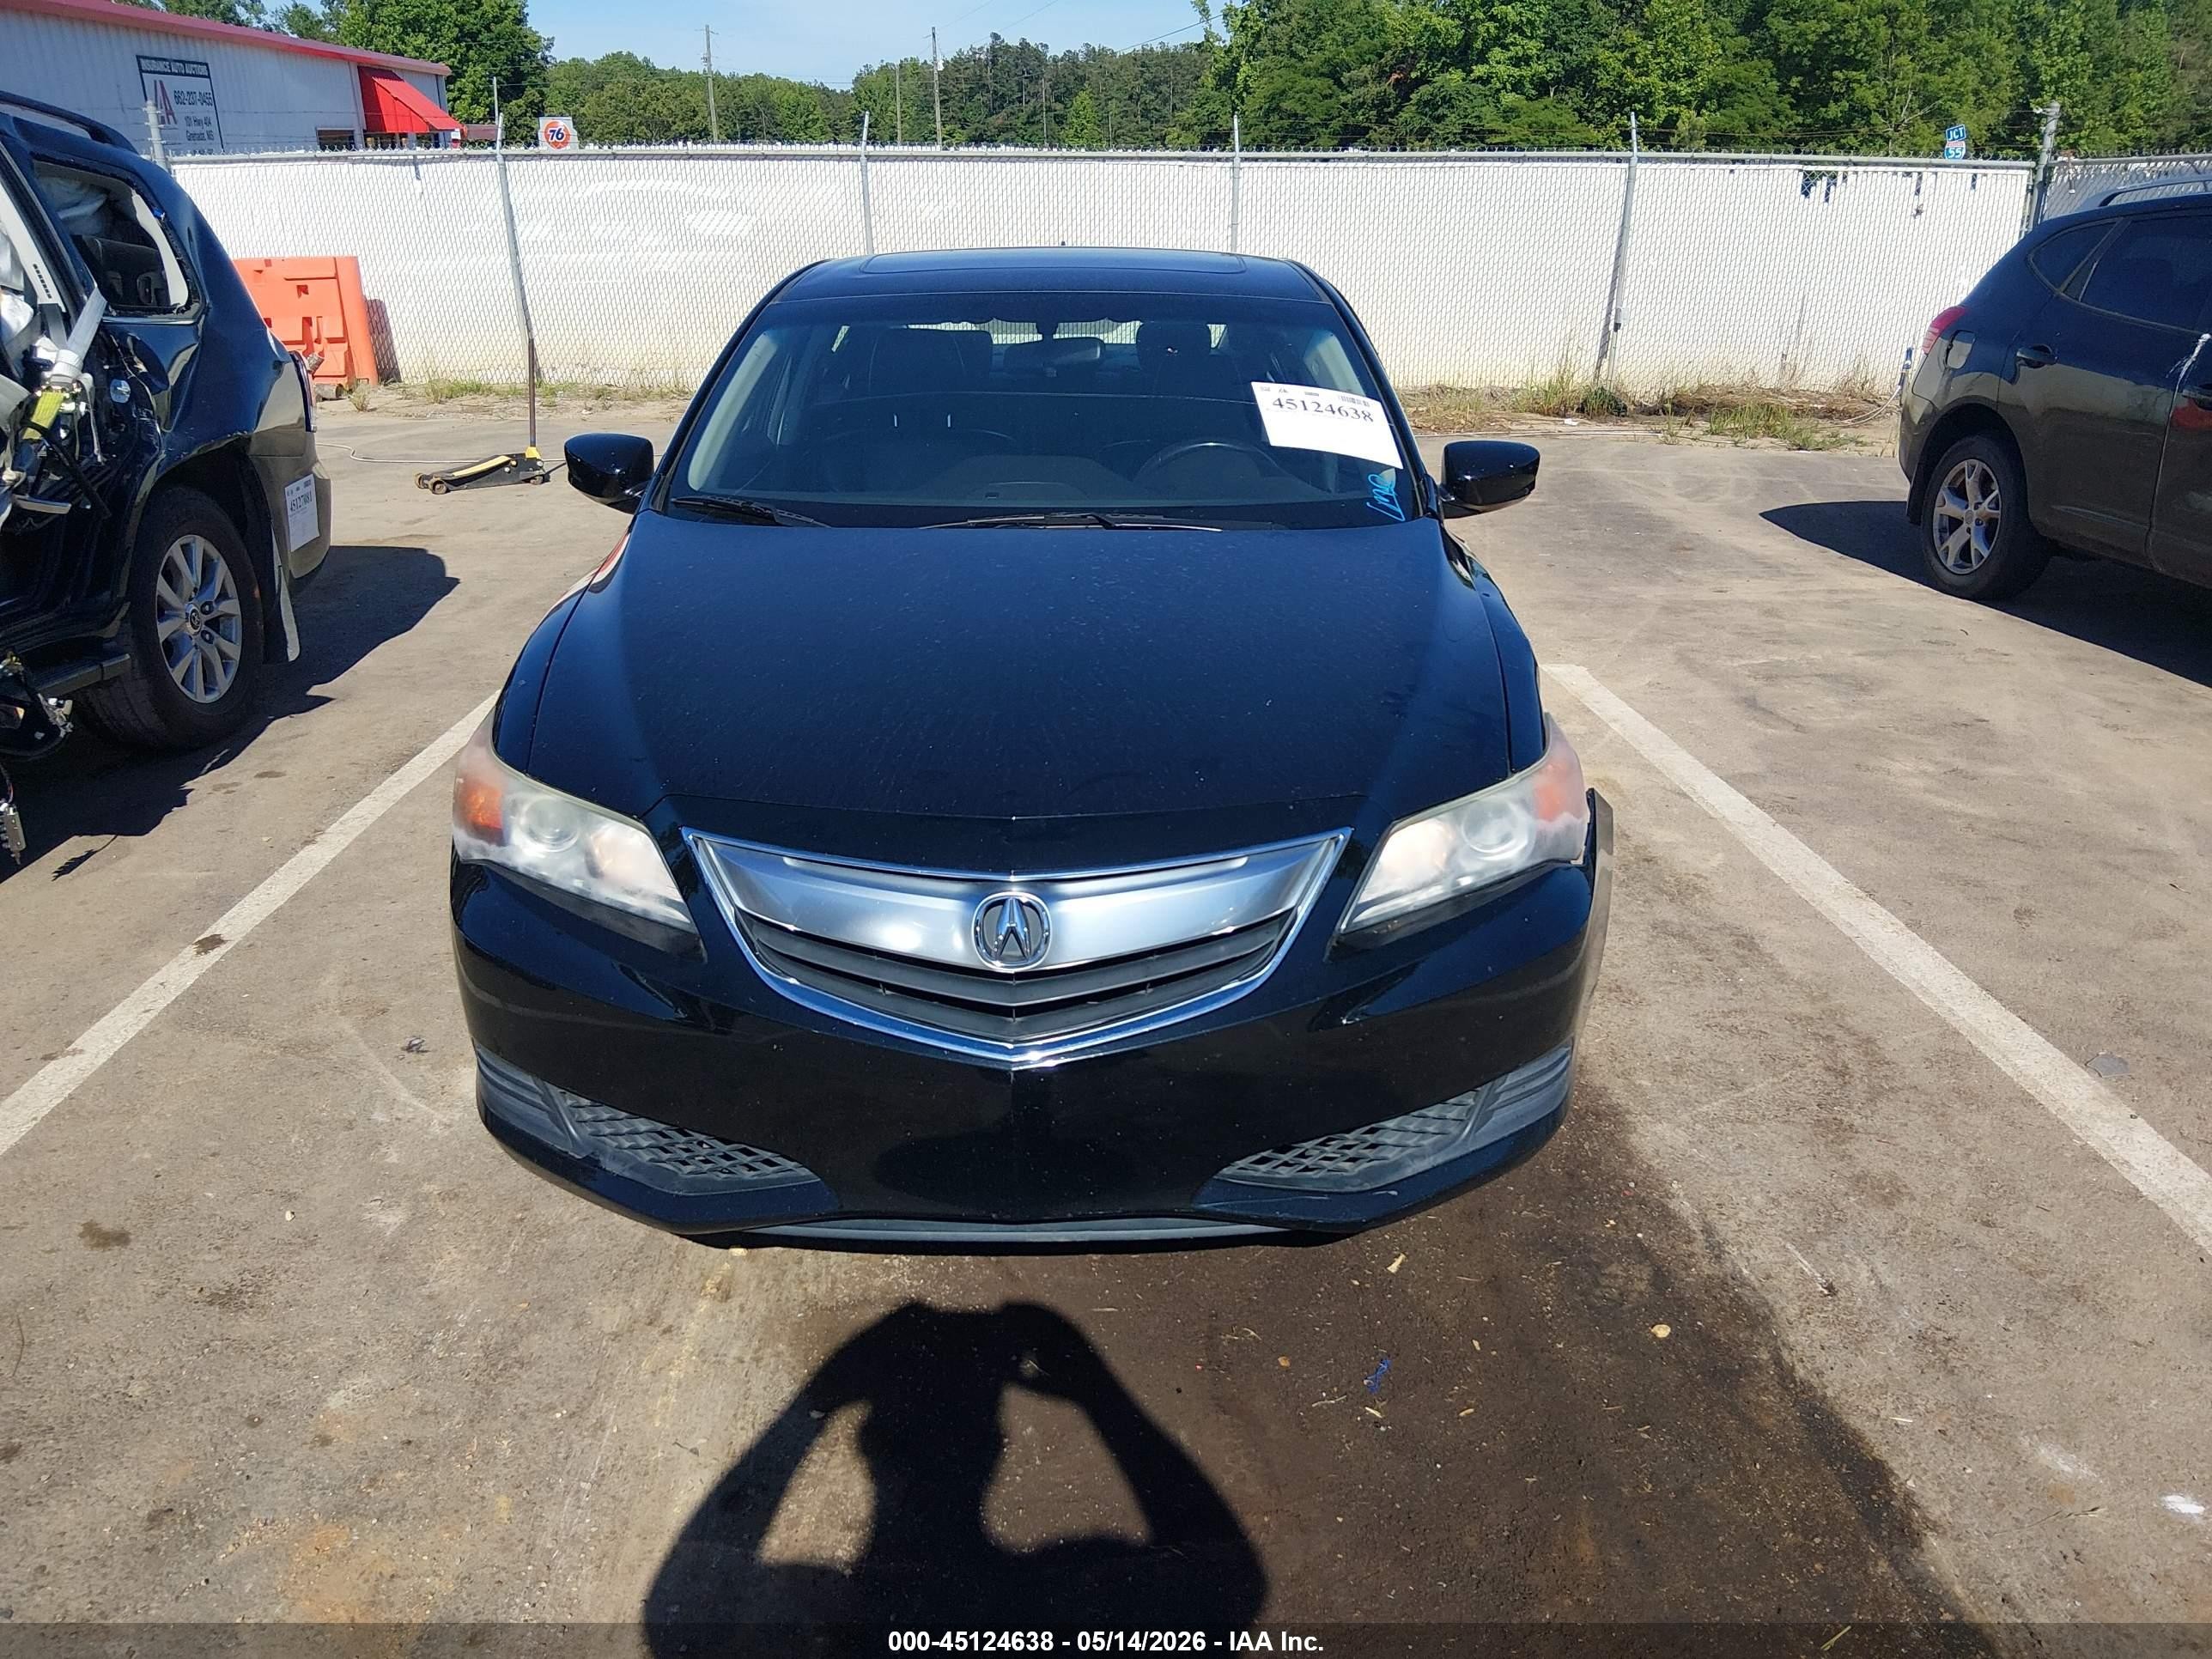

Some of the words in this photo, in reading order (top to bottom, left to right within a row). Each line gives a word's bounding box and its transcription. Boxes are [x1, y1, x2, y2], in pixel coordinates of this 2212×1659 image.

[172, 62, 185, 74] AUTO
[185, 63, 209, 76] AUCTIONS
[193, 116, 204, 130] Hwy
[549, 127, 565, 141] 76
[1948, 127, 1964, 141] JCT
[1948, 147, 1962, 159] 55
[1272, 397, 1374, 422] 45124638
